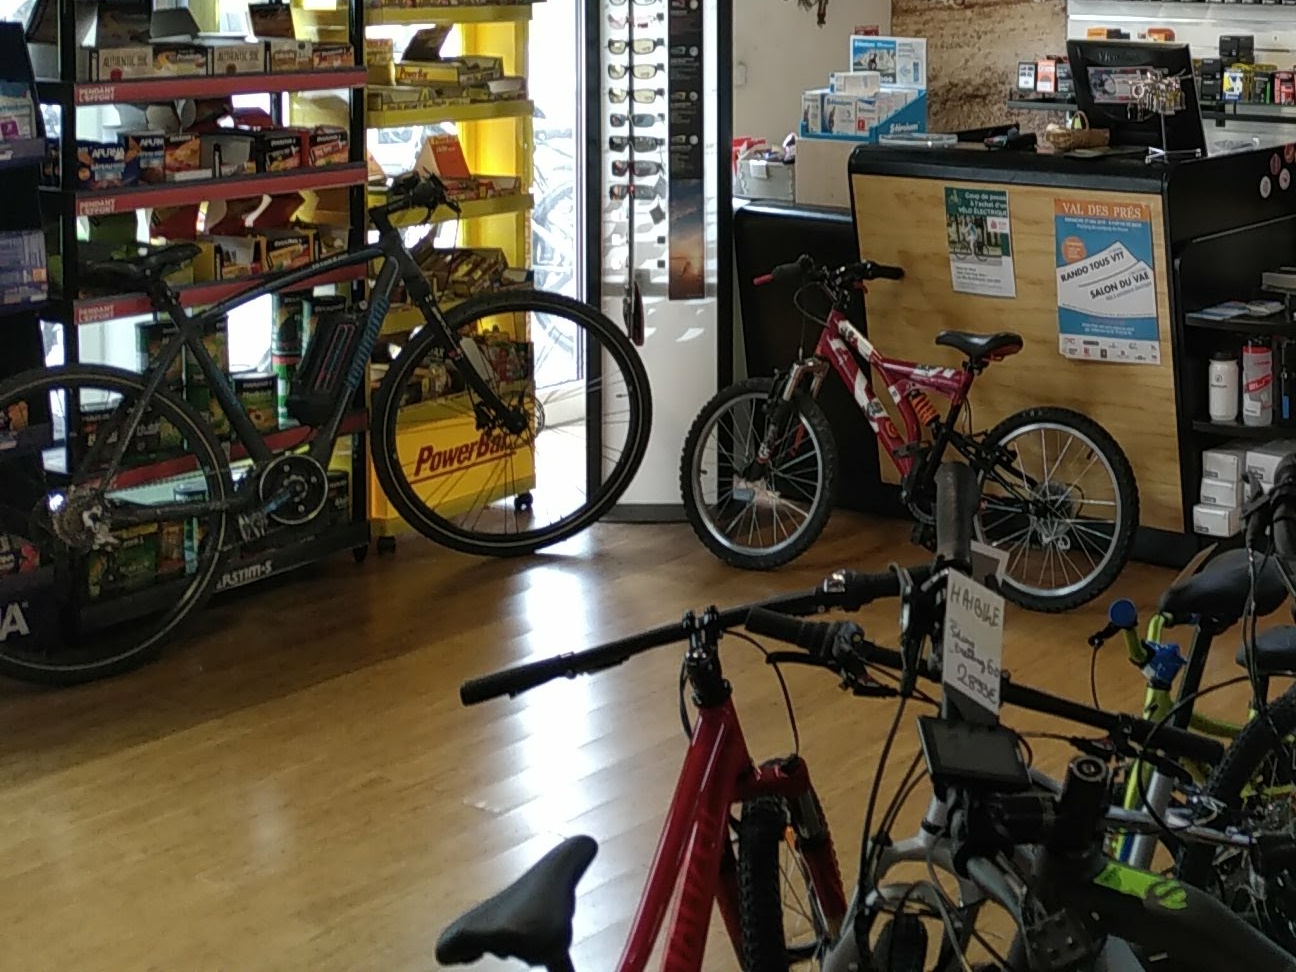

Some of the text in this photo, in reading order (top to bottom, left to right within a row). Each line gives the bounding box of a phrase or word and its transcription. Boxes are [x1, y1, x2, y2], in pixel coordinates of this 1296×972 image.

[79, 86, 116, 96] PENDANT
[79, 93, 116, 103] L'EFFORT
[79, 199, 116, 209] PENDANT
[79, 206, 116, 216] L'EFFORT
[1062, 202, 1142, 218] VAL DES PRÉS
[1060, 250, 1125, 282] RANDO TOUS VTT
[1090, 282, 1118, 299] SALON
[1119, 275, 1132, 288] DU
[1133, 271, 1150, 284] VAE
[79, 304, 115, 316] PENDANT
[79, 312, 115, 323] L'EFFORT
[949, 583, 1001, 627] HAIBIKE
